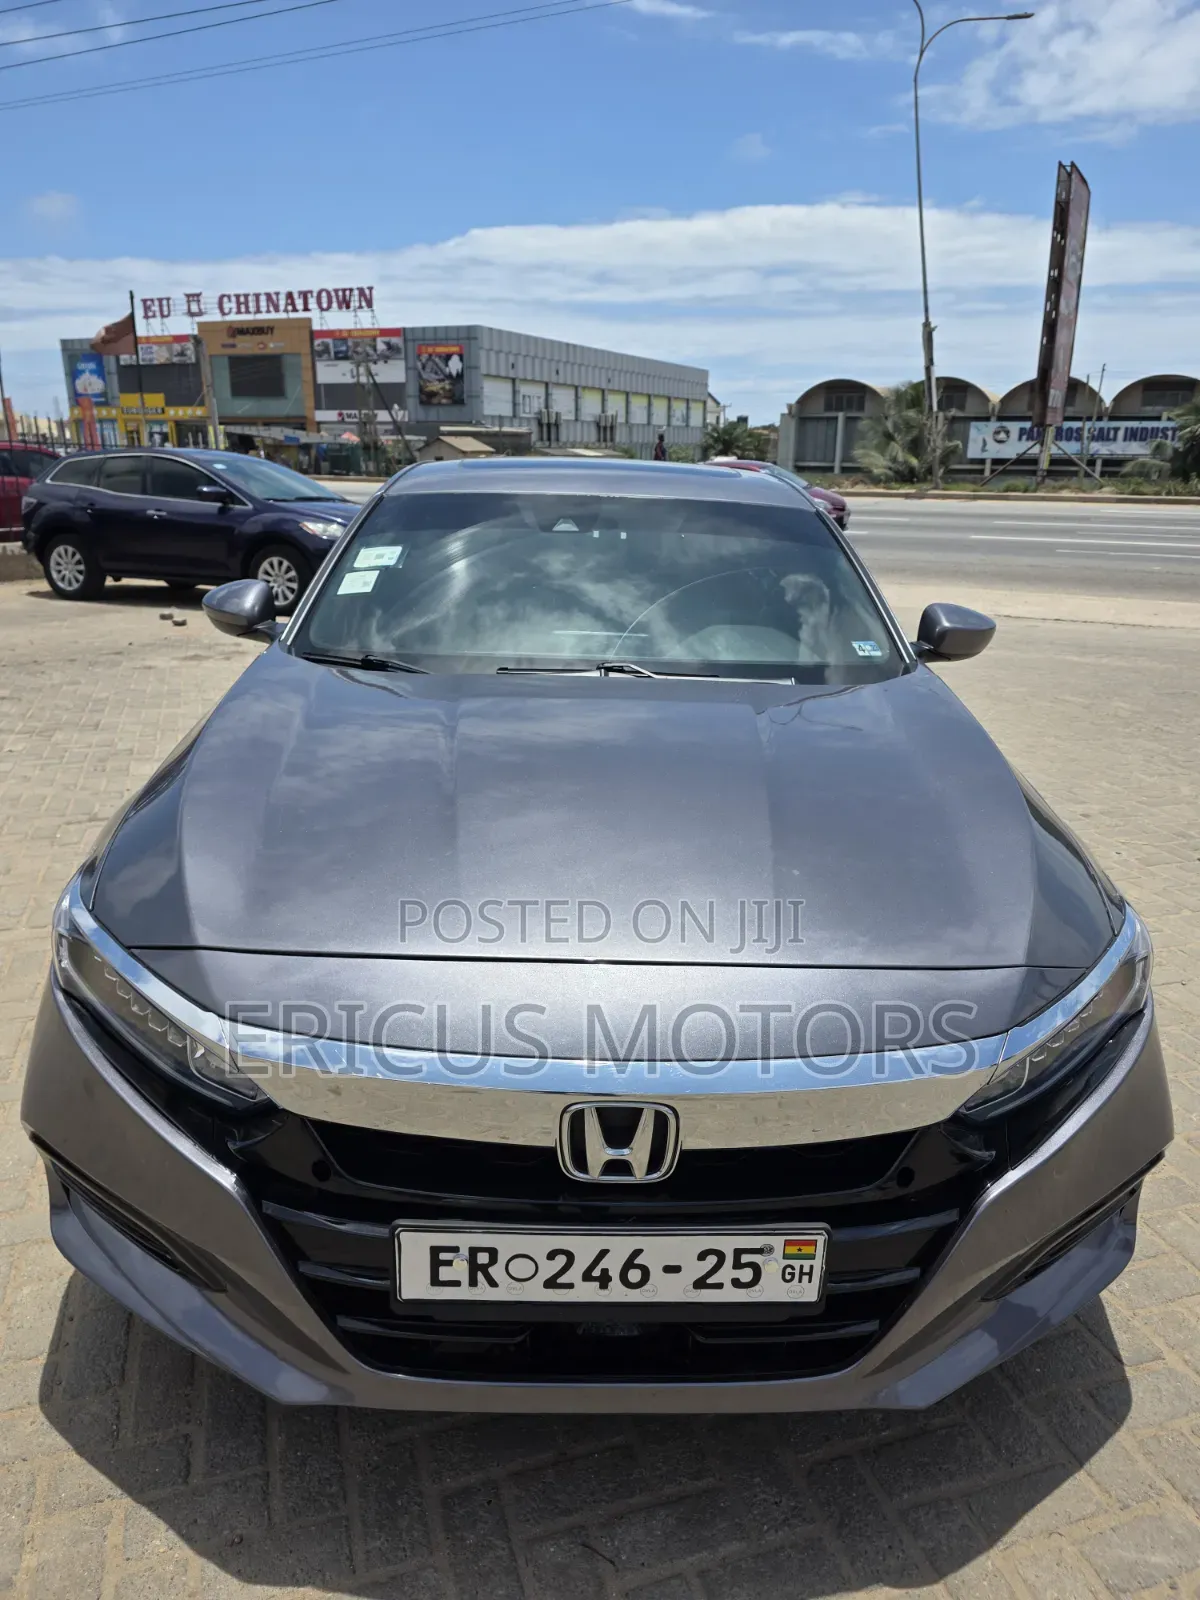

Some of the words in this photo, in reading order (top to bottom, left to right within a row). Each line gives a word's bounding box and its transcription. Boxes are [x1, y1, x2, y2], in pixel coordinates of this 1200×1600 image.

[141, 297, 171, 319] EU
[218, 286, 374, 316] CHINATOWN
[1086, 426, 1120, 442] SALT
[429, 1245, 499, 1288] ER
[781, 1264, 815, 1284] GH
